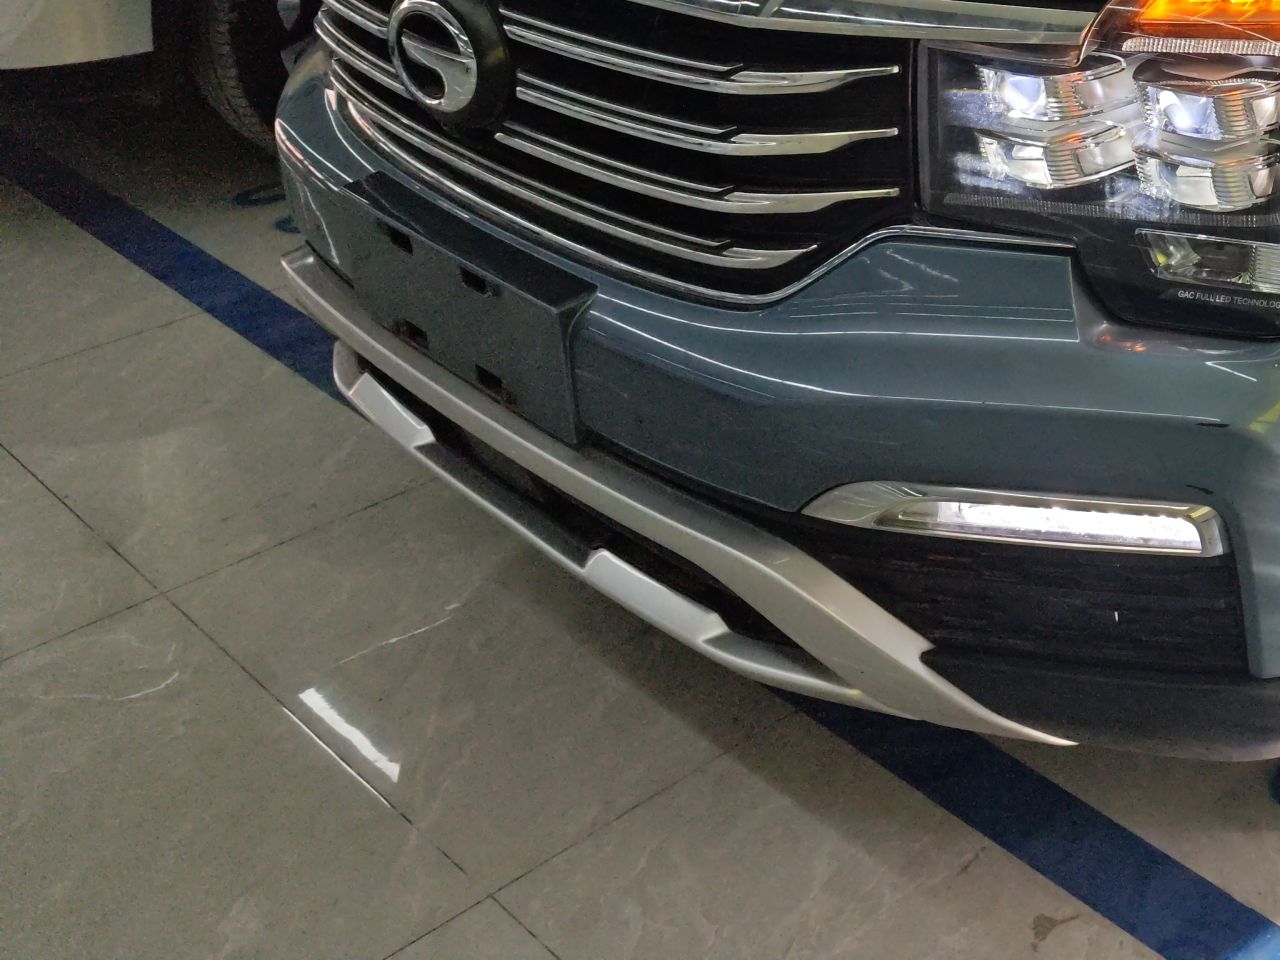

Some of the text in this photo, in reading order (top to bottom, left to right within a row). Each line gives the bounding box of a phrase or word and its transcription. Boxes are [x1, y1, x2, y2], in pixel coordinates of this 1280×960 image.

[1177, 290, 1195, 300] GAC
[1196, 292, 1215, 302] FULL
[1215, 294, 1231, 304] LED
